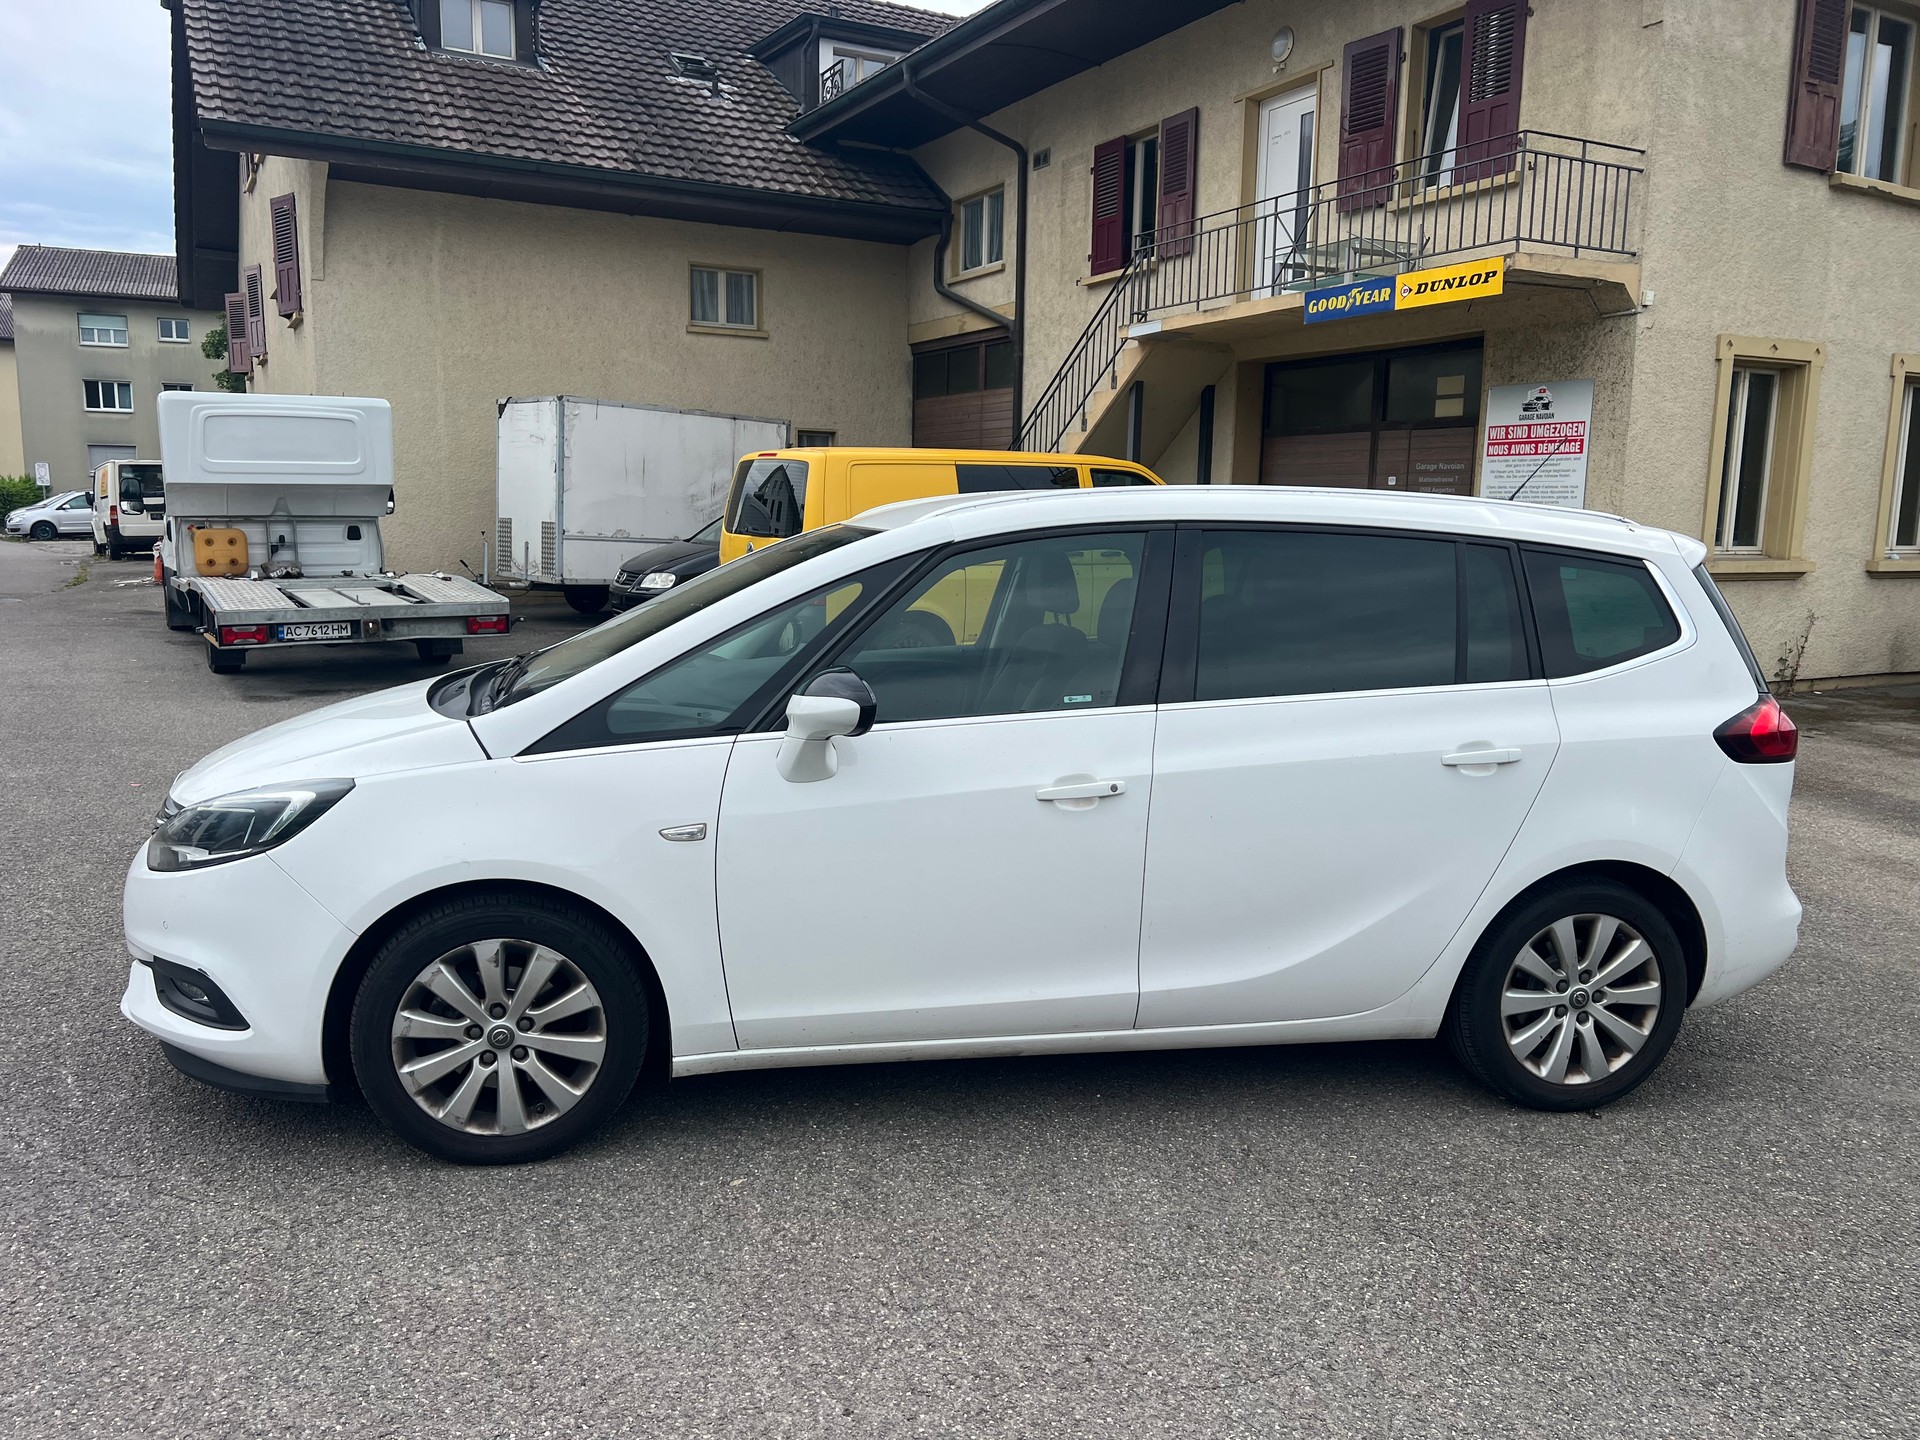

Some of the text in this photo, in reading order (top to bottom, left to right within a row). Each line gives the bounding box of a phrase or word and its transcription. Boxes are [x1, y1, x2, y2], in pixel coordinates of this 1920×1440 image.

[1414, 270, 1498, 295] DUNLOP
[1518, 413, 1536, 421] GARAGE
[1489, 422, 1585, 440] WIR SIND UMGEZOGEN
[1488, 444, 1509, 455] NOUS
[1510, 443, 1536, 454] AVONS
[1415, 462, 1465, 471] Garage Navoian
[285, 624, 349, 637] AC 7612 HM
